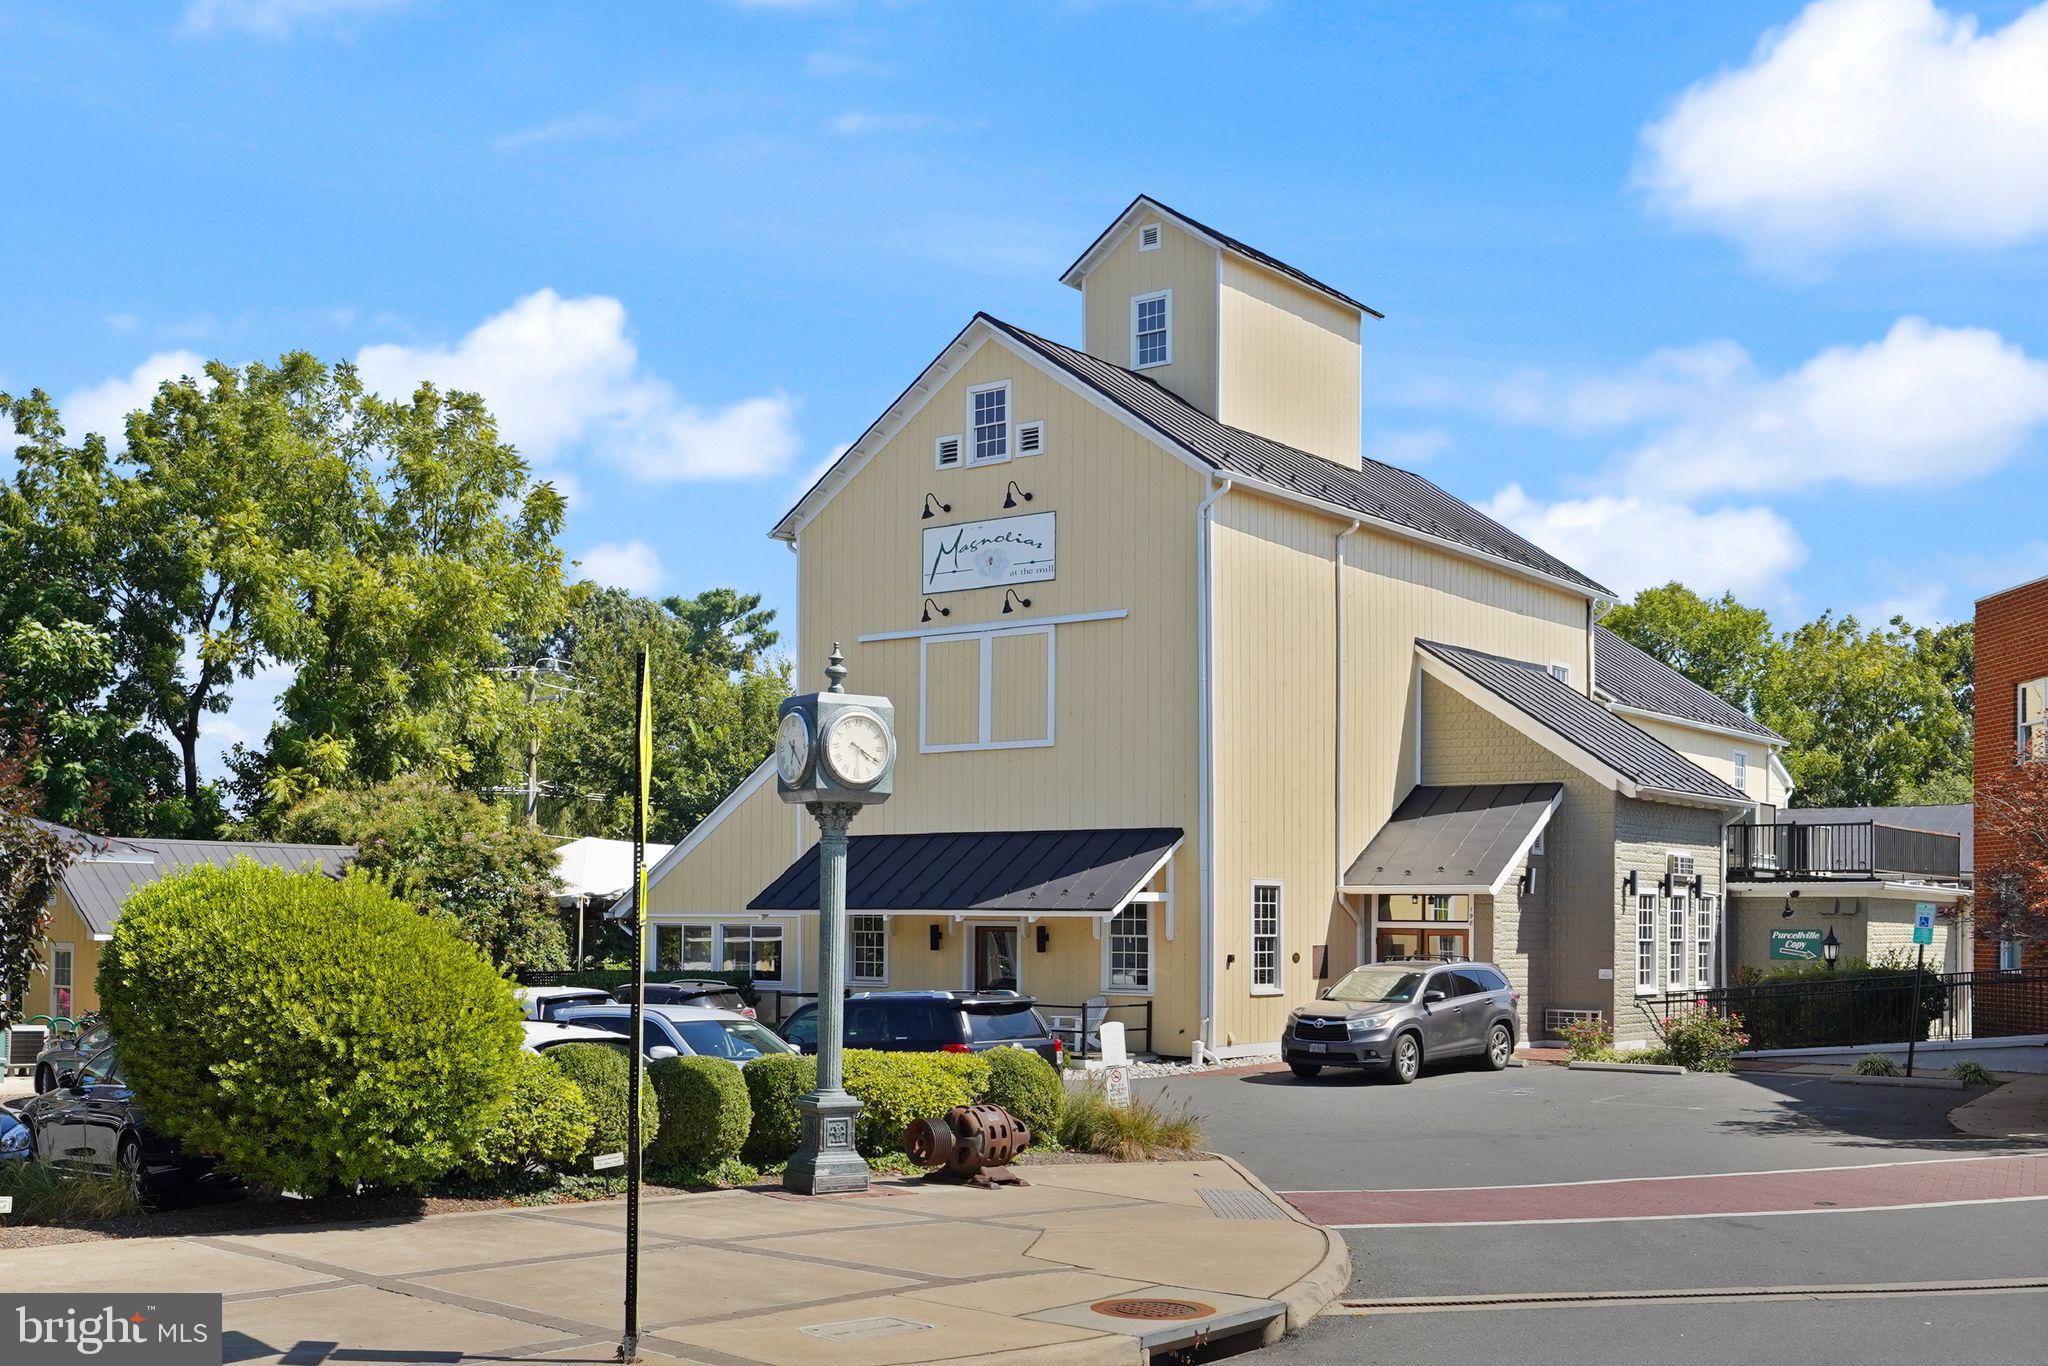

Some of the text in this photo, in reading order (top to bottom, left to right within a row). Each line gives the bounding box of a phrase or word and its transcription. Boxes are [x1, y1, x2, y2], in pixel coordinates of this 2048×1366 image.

[930, 528, 1042, 585] Magnolias
[1009, 569, 1018, 577] at
[1020, 567, 1034, 576] the
[1772, 931, 1820, 940] Purcellville
[1785, 940, 1807, 950] Copy
